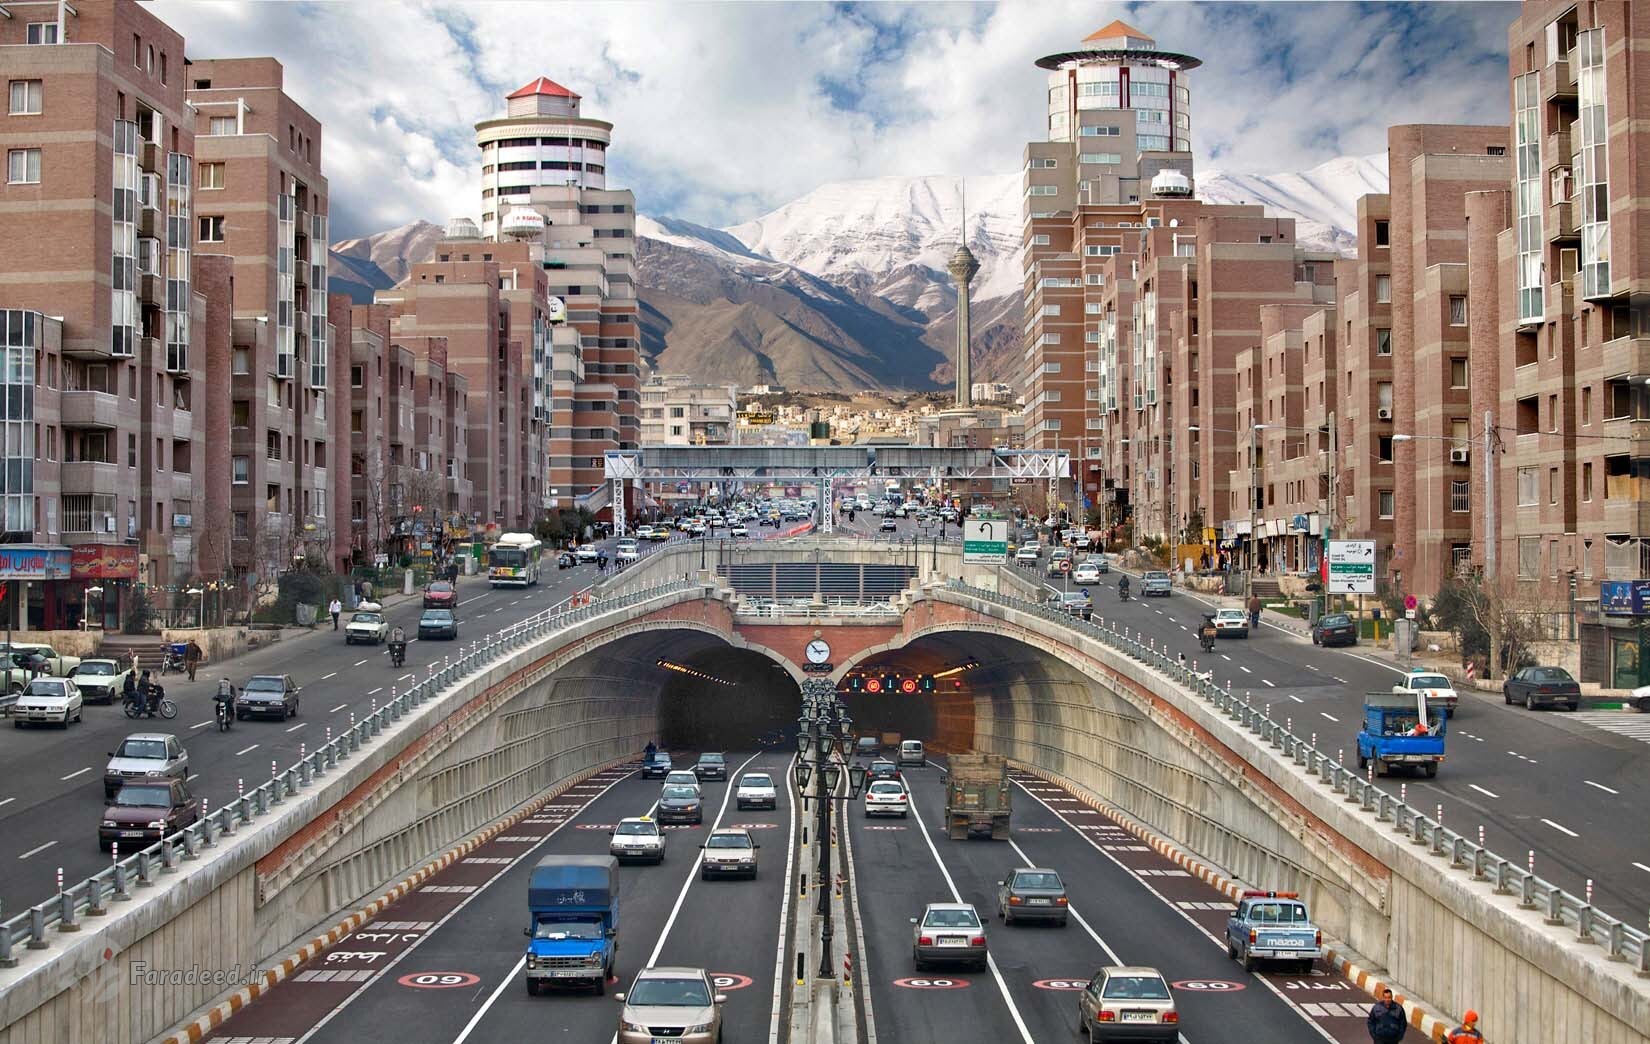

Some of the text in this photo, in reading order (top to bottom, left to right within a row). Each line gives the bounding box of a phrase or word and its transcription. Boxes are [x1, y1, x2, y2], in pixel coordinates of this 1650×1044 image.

[1266, 938, 1305, 947] mazda
[324, 951, 388, 965] فقط
[415, 975, 463, 984] 60
[910, 979, 953, 987] 60
[1285, 980, 1351, 990] امداد
